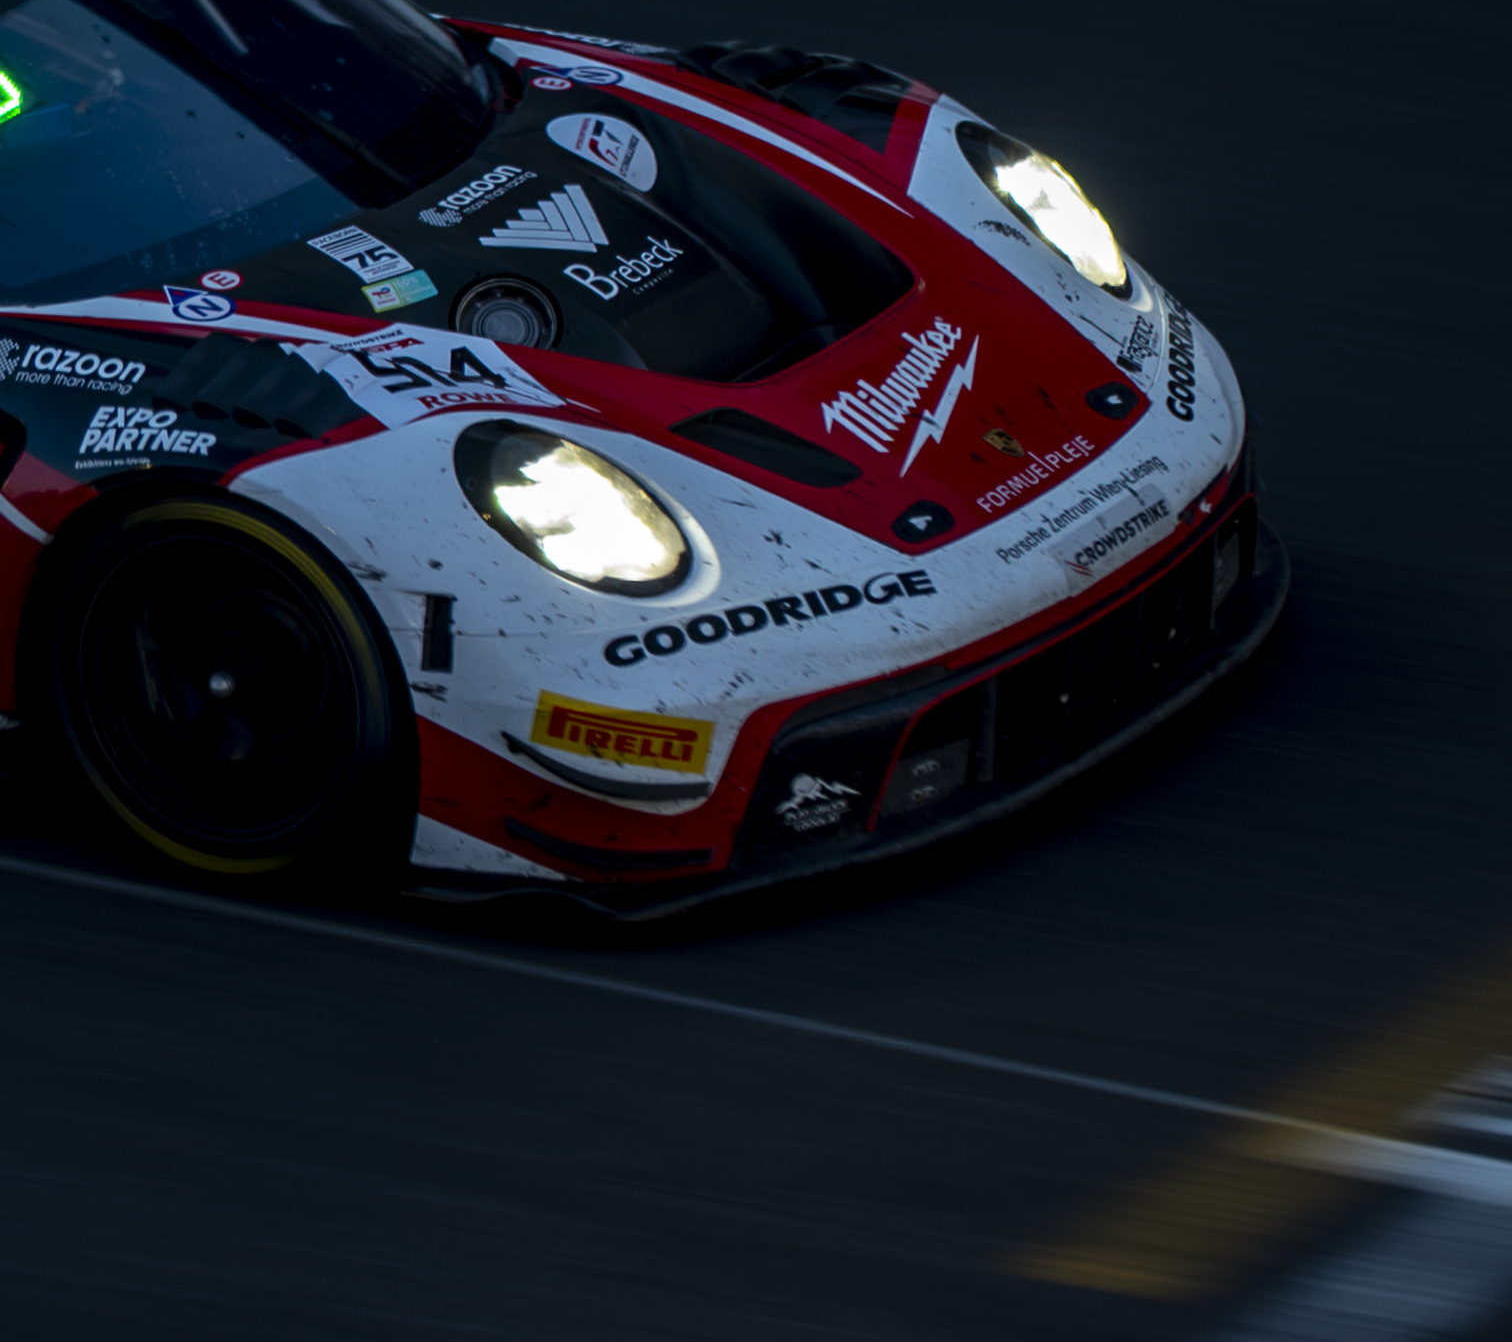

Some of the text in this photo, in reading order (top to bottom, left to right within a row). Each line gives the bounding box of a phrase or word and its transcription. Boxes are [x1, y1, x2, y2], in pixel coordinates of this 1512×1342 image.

[437, 164, 523, 211] razoon
[340, 245, 400, 269] 75
[562, 235, 685, 301] Brebeck
[15, 370, 134, 397] more than racing
[21, 343, 148, 384] razoon
[820, 315, 963, 454] Milwaukee
[78, 427, 218, 456] PARTNER
[88, 404, 179, 429] EXPO
[996, 525, 1052, 565] Porsche
[1041, 495, 1098, 533] Zentrum
[1074, 498, 1171, 568] CROWDSTRIKE
[604, 569, 938, 667] GOODRIDGE
[548, 705, 698, 763] PIRELLI
